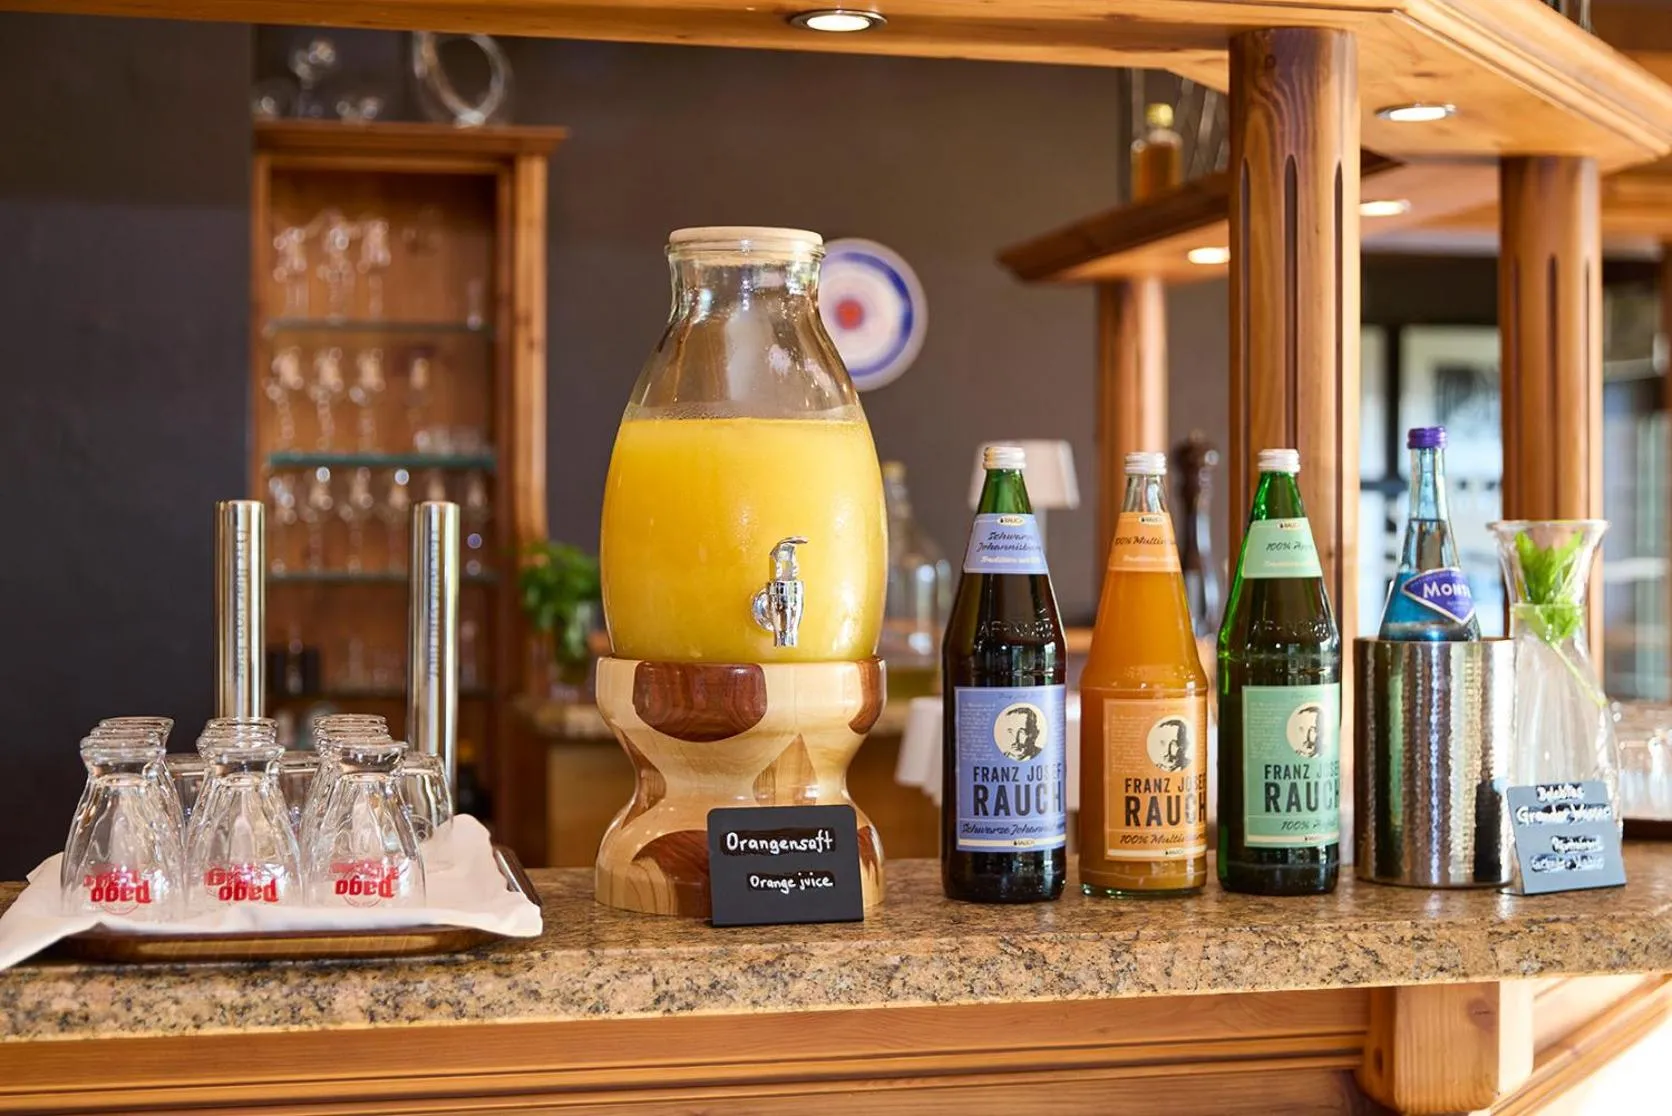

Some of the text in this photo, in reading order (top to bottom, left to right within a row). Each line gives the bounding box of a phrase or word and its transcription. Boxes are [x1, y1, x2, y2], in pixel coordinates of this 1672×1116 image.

[973, 763, 1062, 782] FRANZ JOSEF
[1264, 760, 1339, 780] FRANZ JOSE
[1125, 778, 1170, 793] FRANZ
[973, 781, 1062, 817] RAUCH
[1125, 791, 1207, 827] RAUCH
[1281, 820, 1309, 831] 100%
[726, 829, 834, 854] Orangensaft
[1120, 834, 1148, 845] 100%
[91, 880, 153, 904] pago
[219, 877, 279, 902] pago
[335, 873, 395, 898] pago
[750, 872, 834, 894] Orange juice
